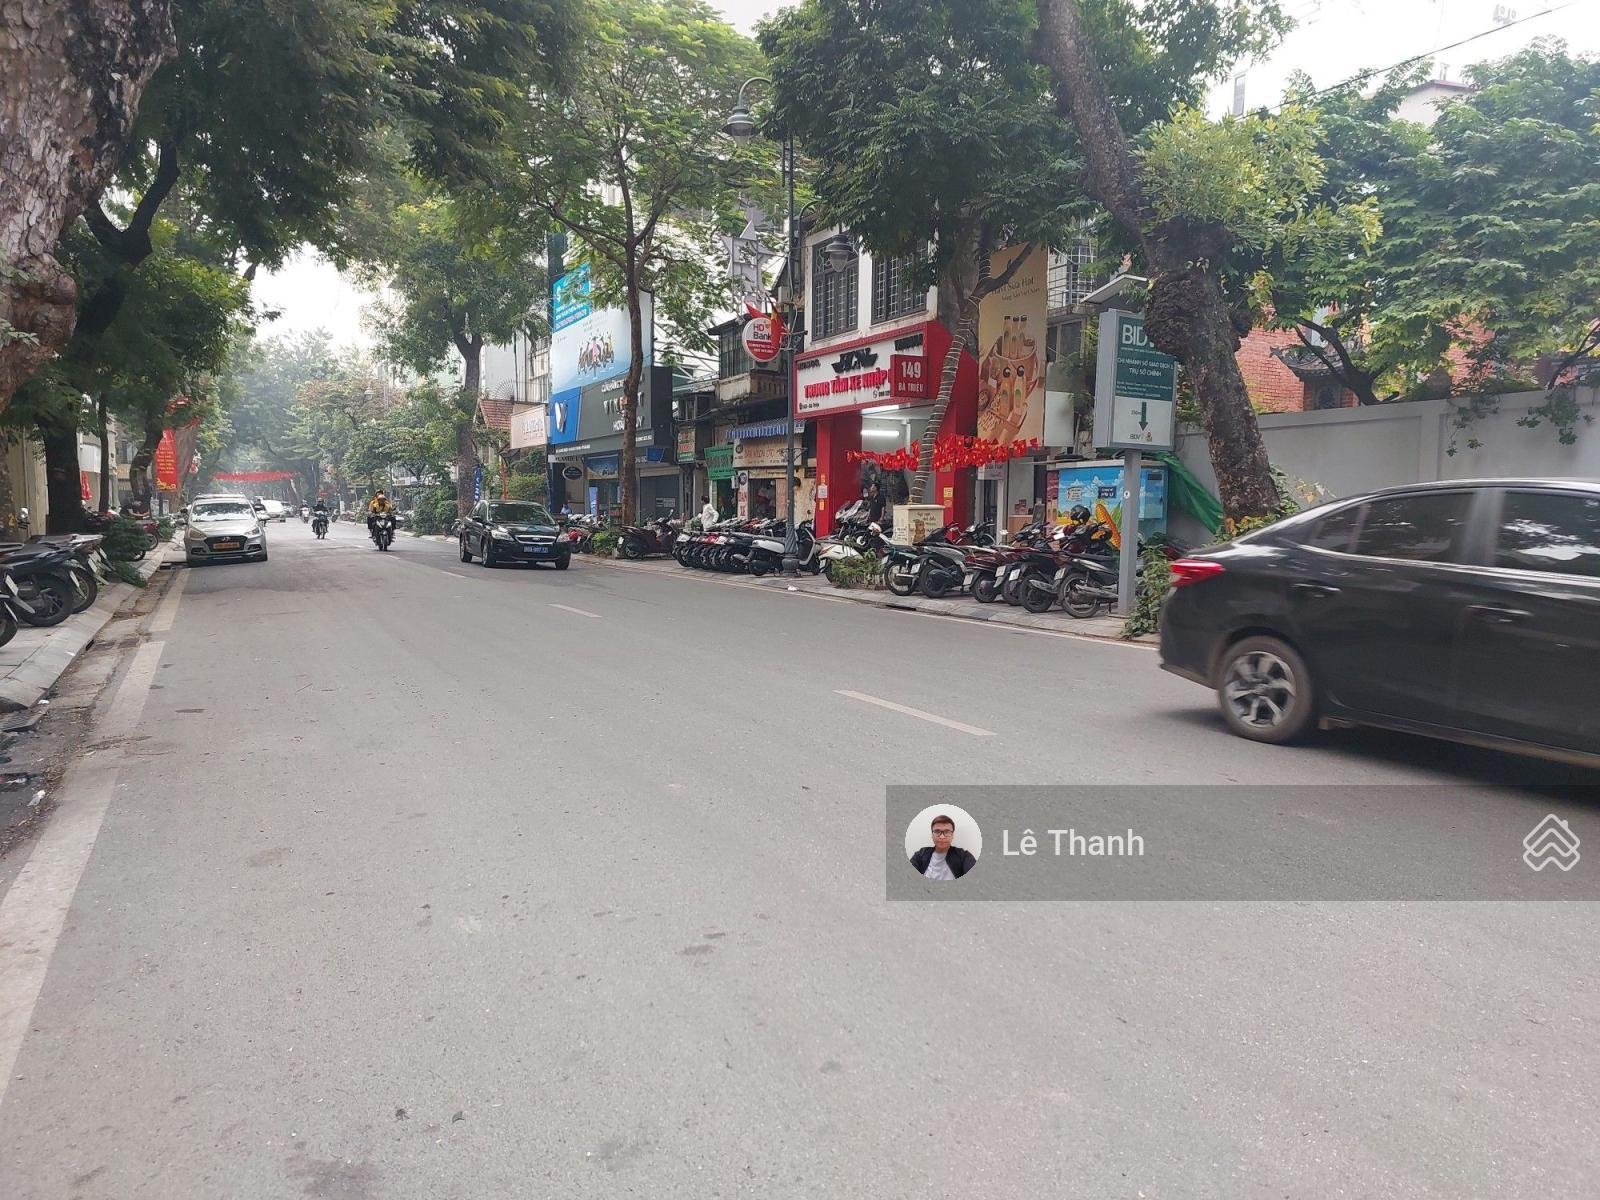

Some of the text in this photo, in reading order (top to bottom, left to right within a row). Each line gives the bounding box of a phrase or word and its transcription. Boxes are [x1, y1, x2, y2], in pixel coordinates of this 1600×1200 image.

[1121, 323, 1155, 348] BID
[901, 361, 921, 379] 149
[804, 381, 831, 399] TRUNG
[848, 374, 862, 391] XE
